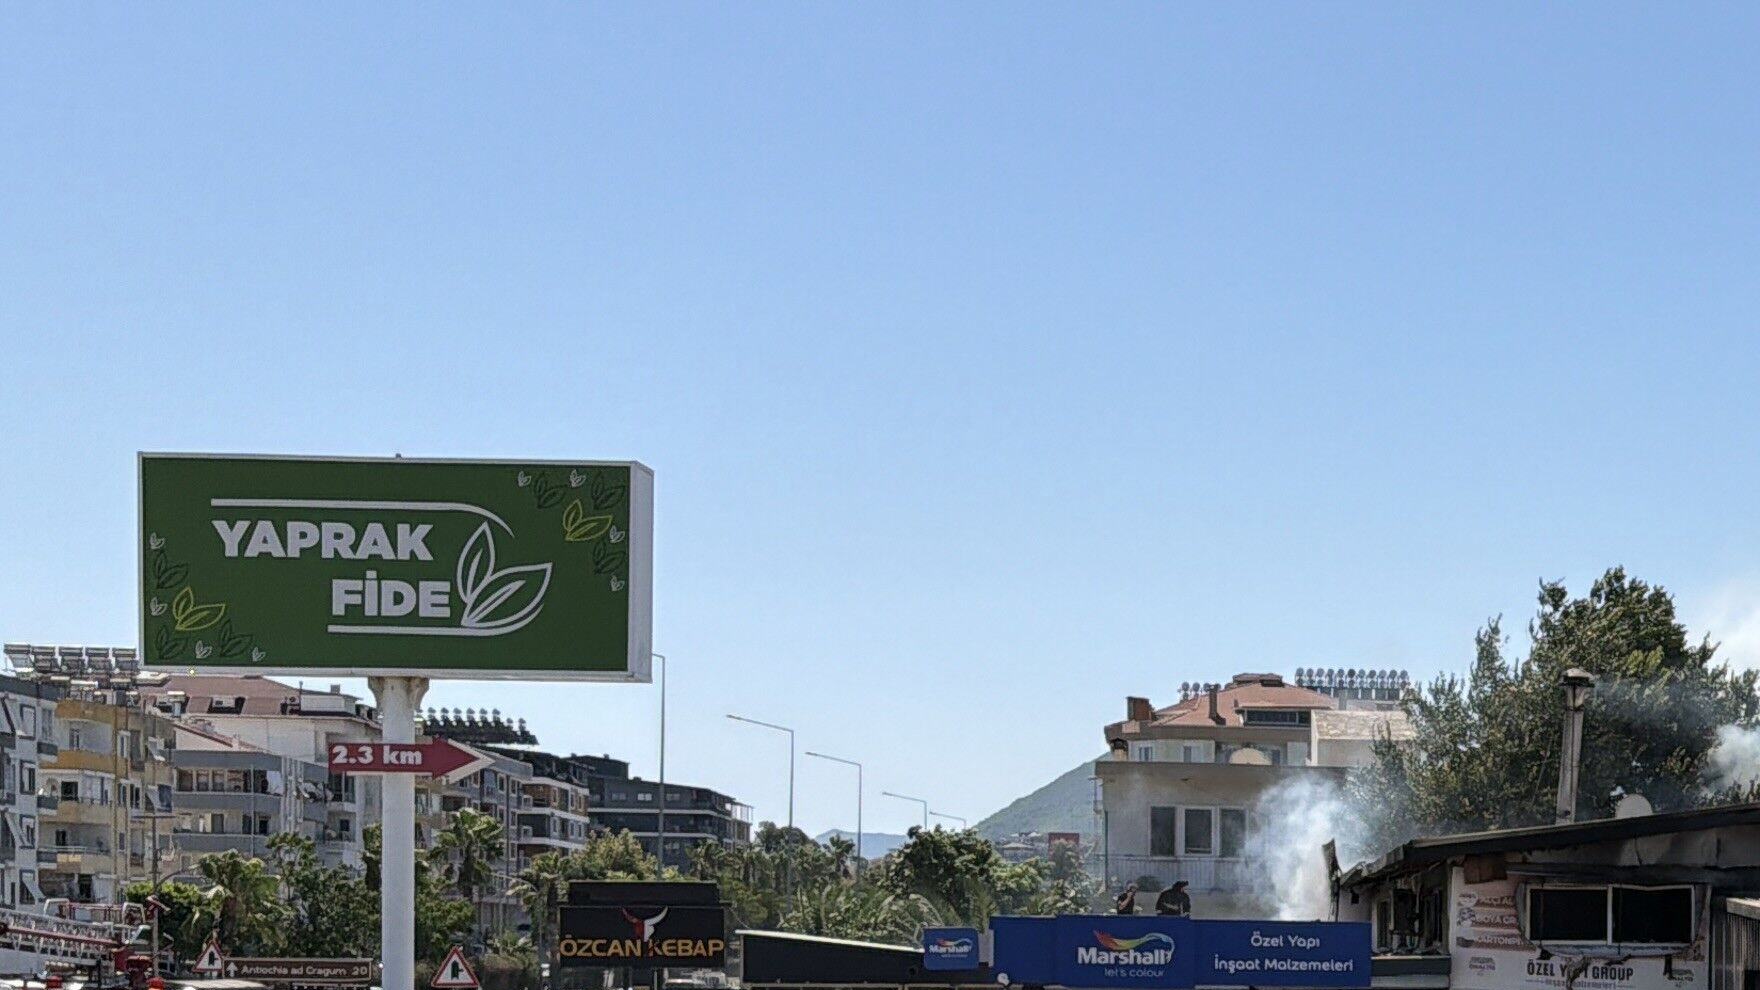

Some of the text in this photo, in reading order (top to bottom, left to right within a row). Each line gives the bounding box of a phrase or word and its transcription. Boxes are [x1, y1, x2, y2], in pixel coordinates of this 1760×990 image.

[211, 520, 434, 561] YAPRAK
[332, 570, 450, 618] FİDE
[332, 745, 422, 765] 2.3 km
[559, 934, 724, 957] ÖZCAN KEBAP
[1250, 931, 1321, 949] Özel Yapı
[1077, 946, 1166, 965] Marshall
[1214, 954, 1354, 974] İnşaat Malzemeleri
[240, 965, 368, 977] Antiochia ad Cragum 20
[1104, 967, 1165, 977] let's colour
[1527, 958, 1555, 976] ÖZEL
[1592, 965, 1634, 981] GROUP
